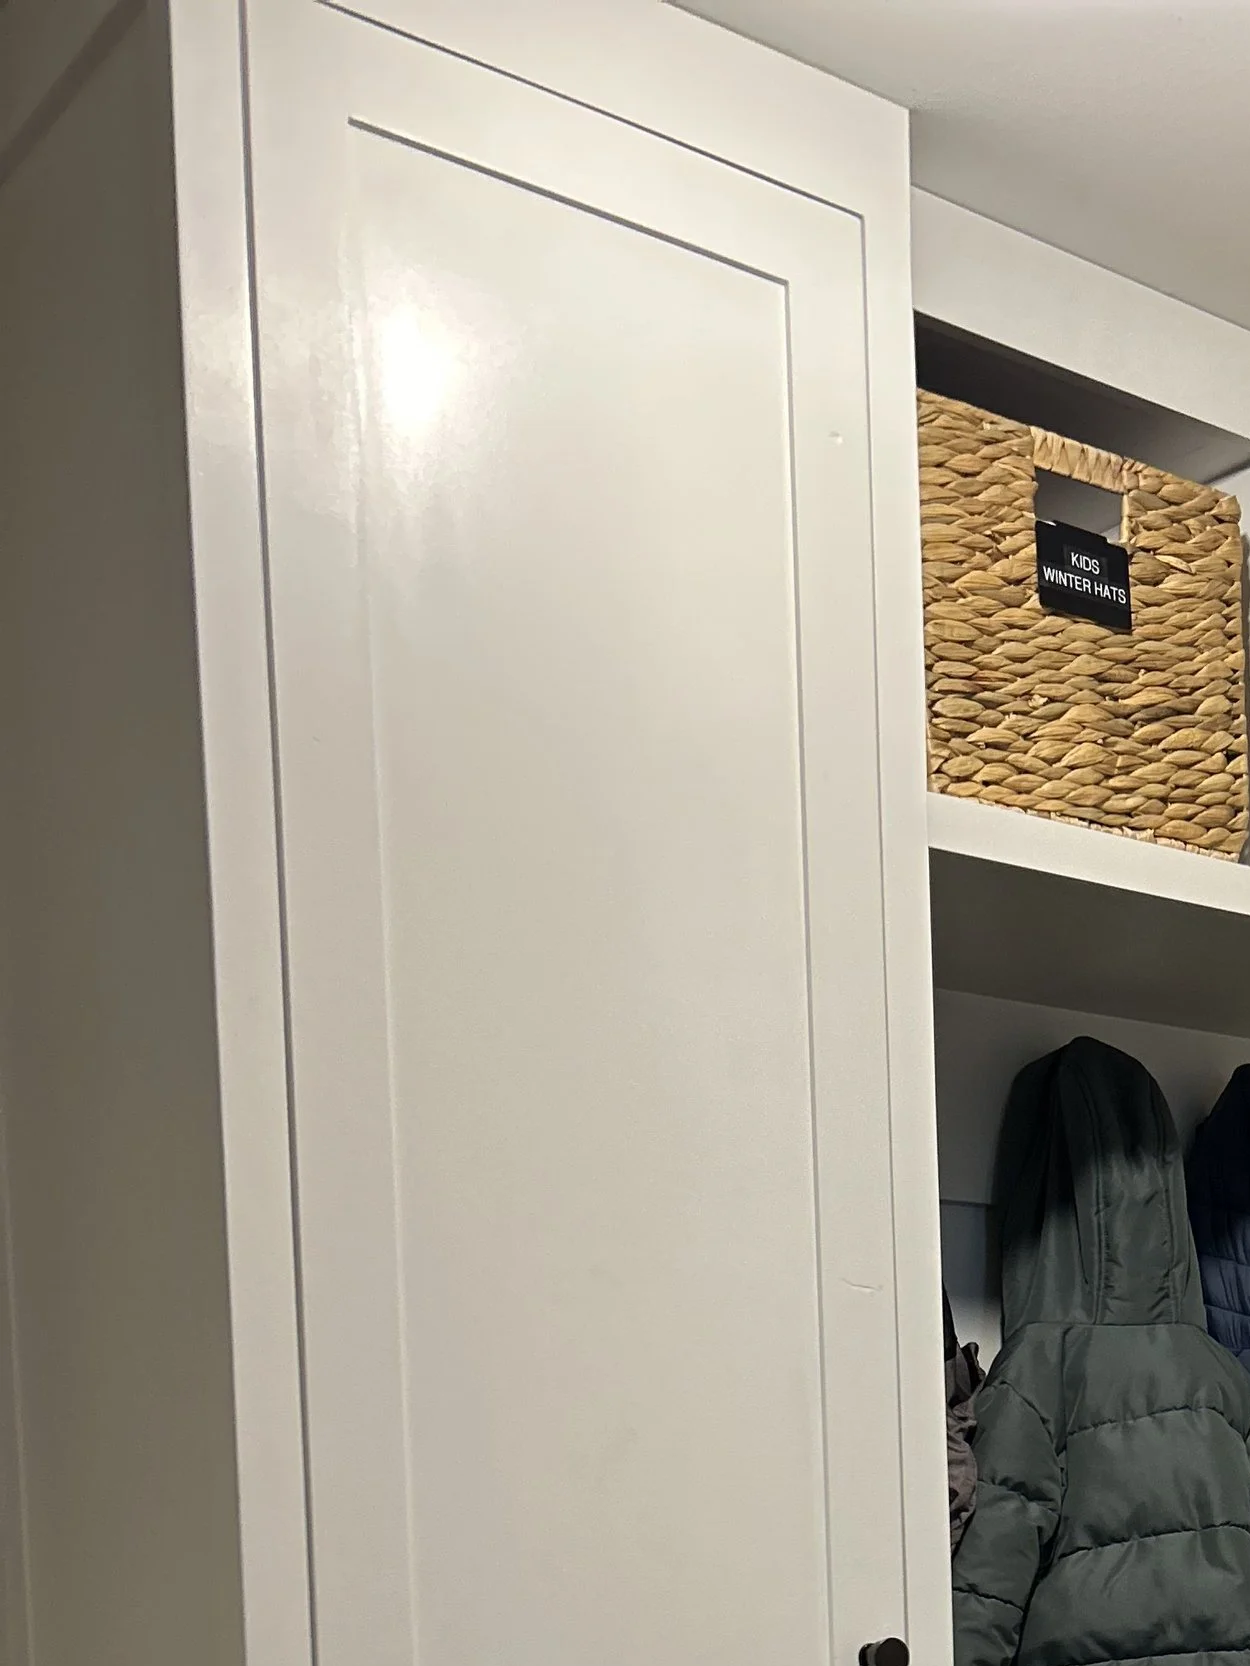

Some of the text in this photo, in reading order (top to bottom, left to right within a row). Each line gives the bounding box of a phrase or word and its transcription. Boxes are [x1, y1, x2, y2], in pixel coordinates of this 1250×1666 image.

[1071, 552, 1100, 575] KIDS
[1043, 565, 1127, 604] WINTER HATS
